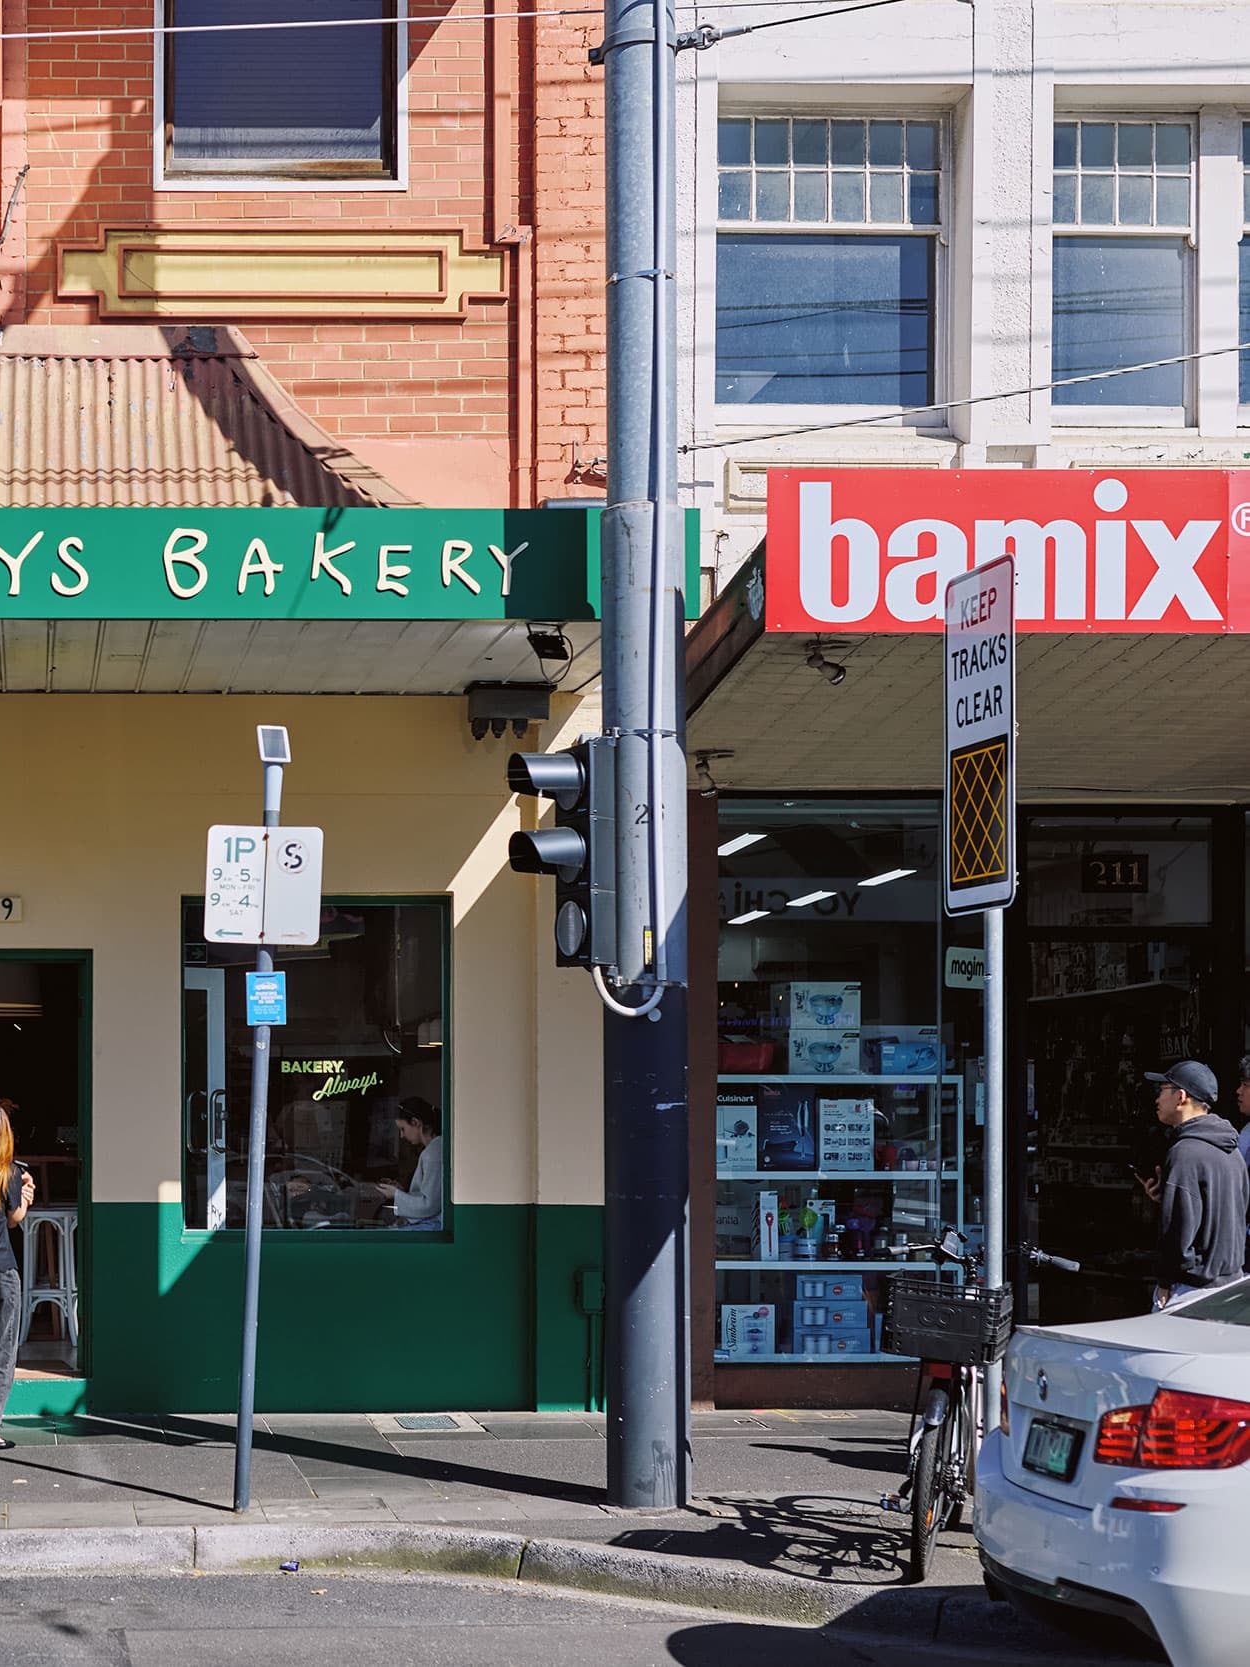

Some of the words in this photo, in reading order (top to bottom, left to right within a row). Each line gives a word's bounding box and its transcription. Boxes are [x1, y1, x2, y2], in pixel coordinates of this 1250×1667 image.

[161, 527, 530, 599] BAKERY
[799, 479, 1224, 622] bamix
[960, 587, 997, 630] KEEP
[952, 633, 1006, 681] TRACKS
[956, 685, 1003, 728] CLEAR
[224, 837, 256, 863] 1P
[1090, 861, 1142, 886] 211
[281, 1060, 345, 1073] BAKERY.
[312, 1071, 383, 1101] Always.
[717, 1094, 754, 1103] Cuisinart
[726, 1307, 738, 1352] Sunbeam
